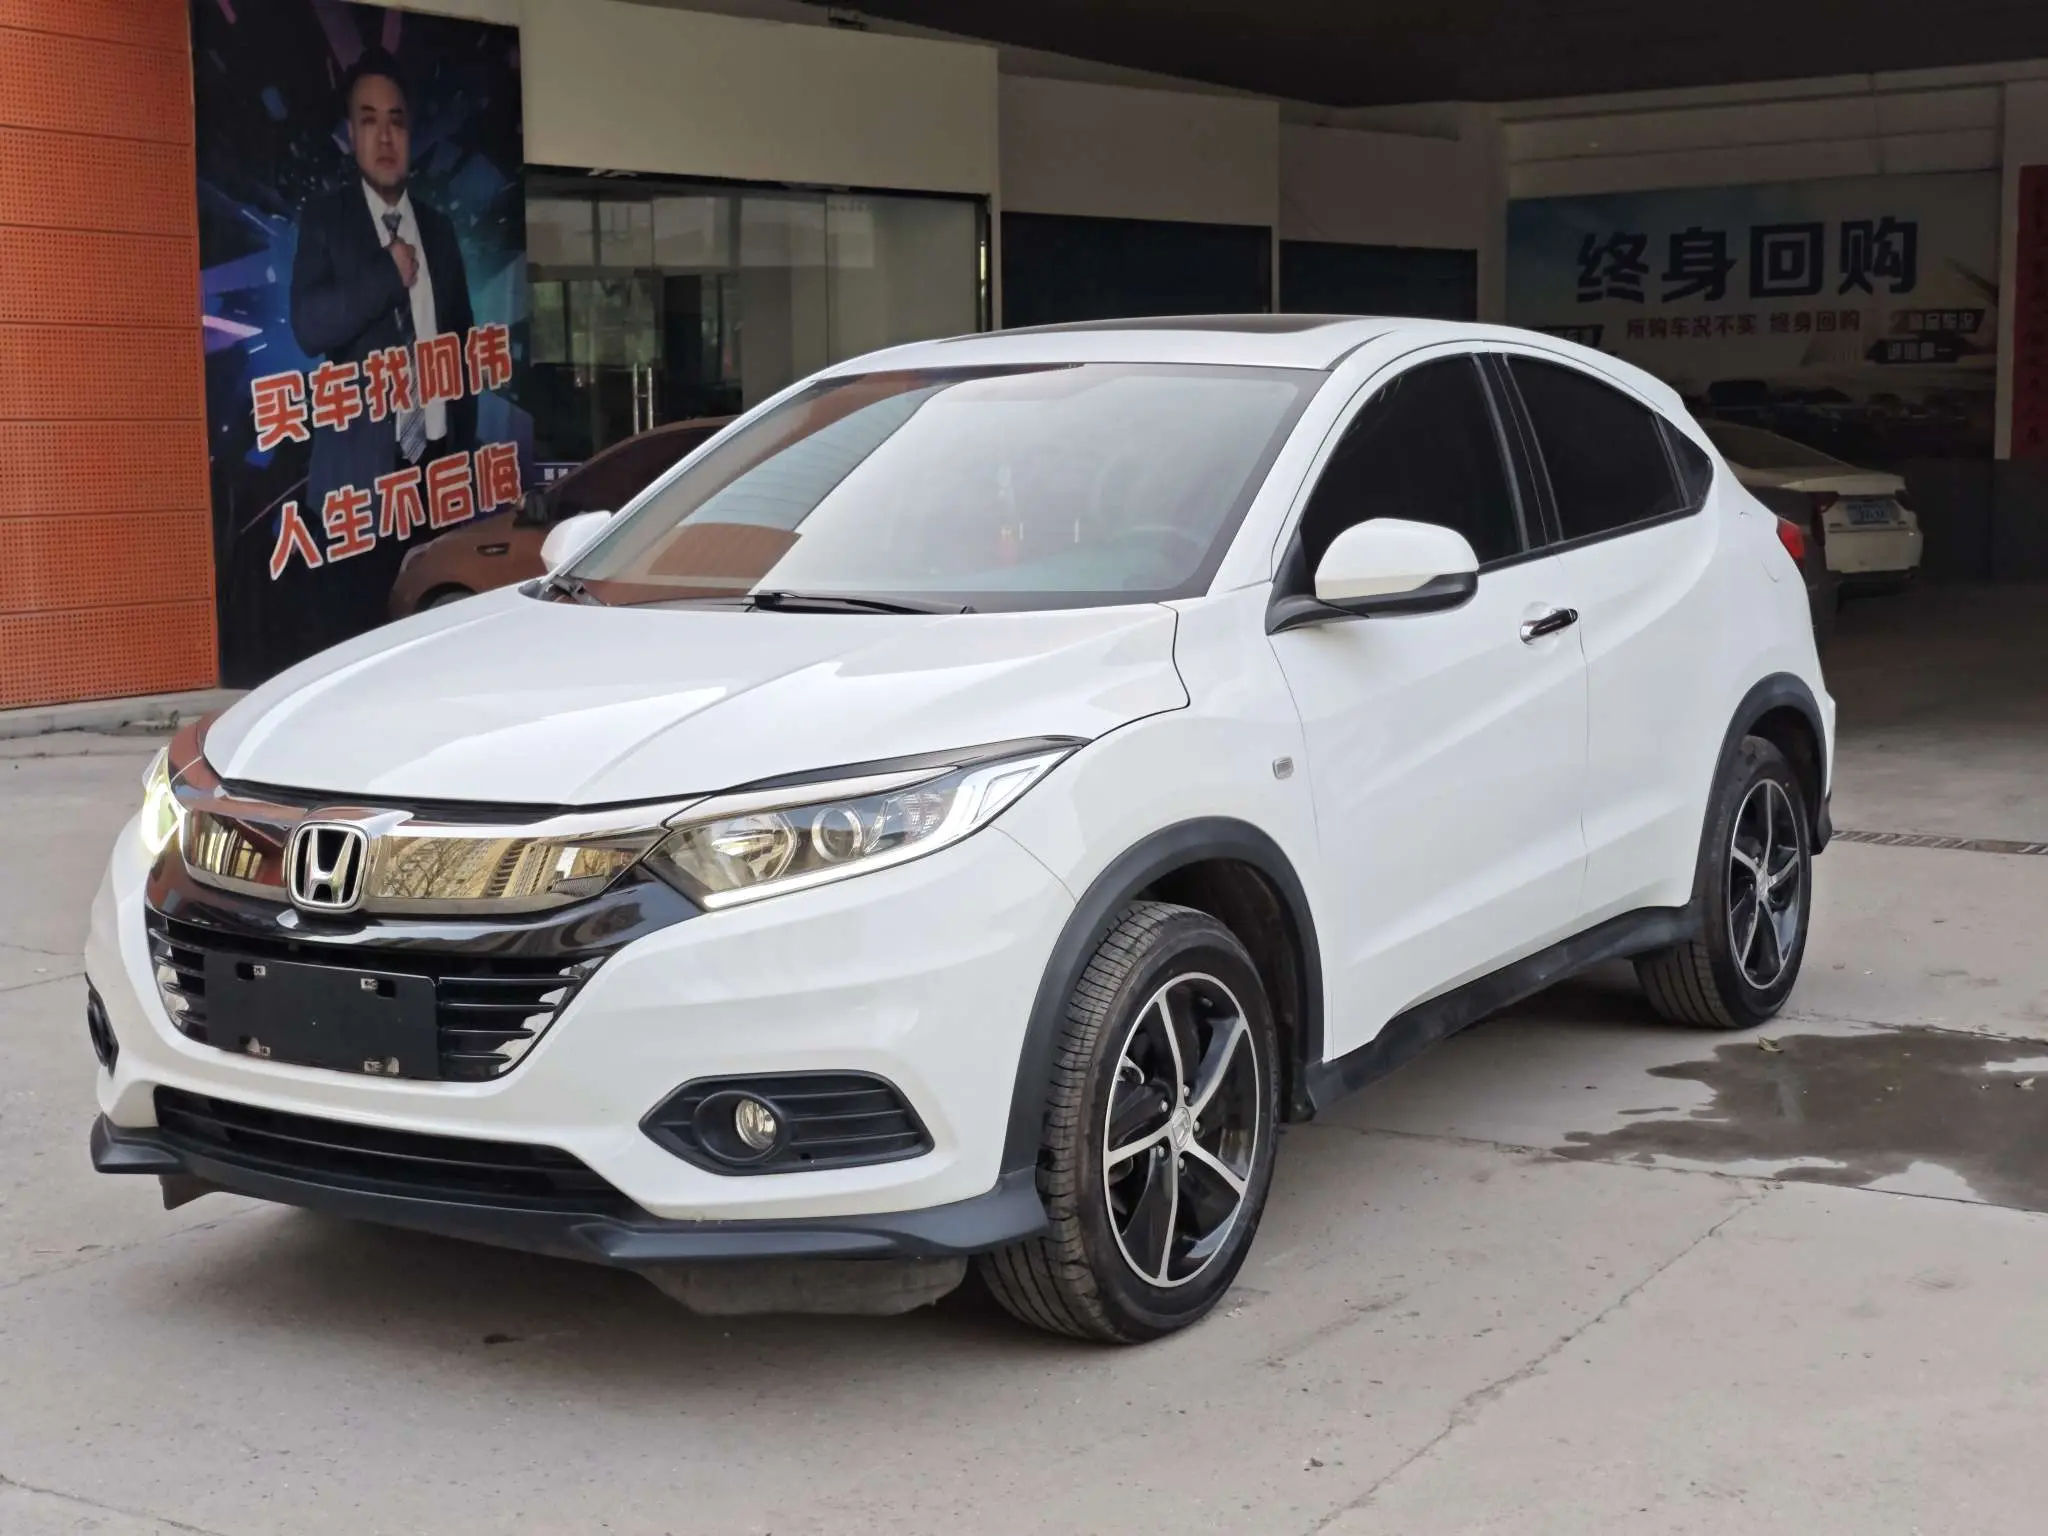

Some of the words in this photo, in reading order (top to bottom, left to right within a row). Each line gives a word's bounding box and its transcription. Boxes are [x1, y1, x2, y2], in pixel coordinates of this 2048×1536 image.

[1576, 215, 1918, 304] 终身回购
[1626, 314, 1757, 341] 所购车况不实
[1769, 309, 1860, 334] 终身回购
[251, 322, 513, 452] 买车找阿伟
[269, 440, 523, 581] 人生不后悔
